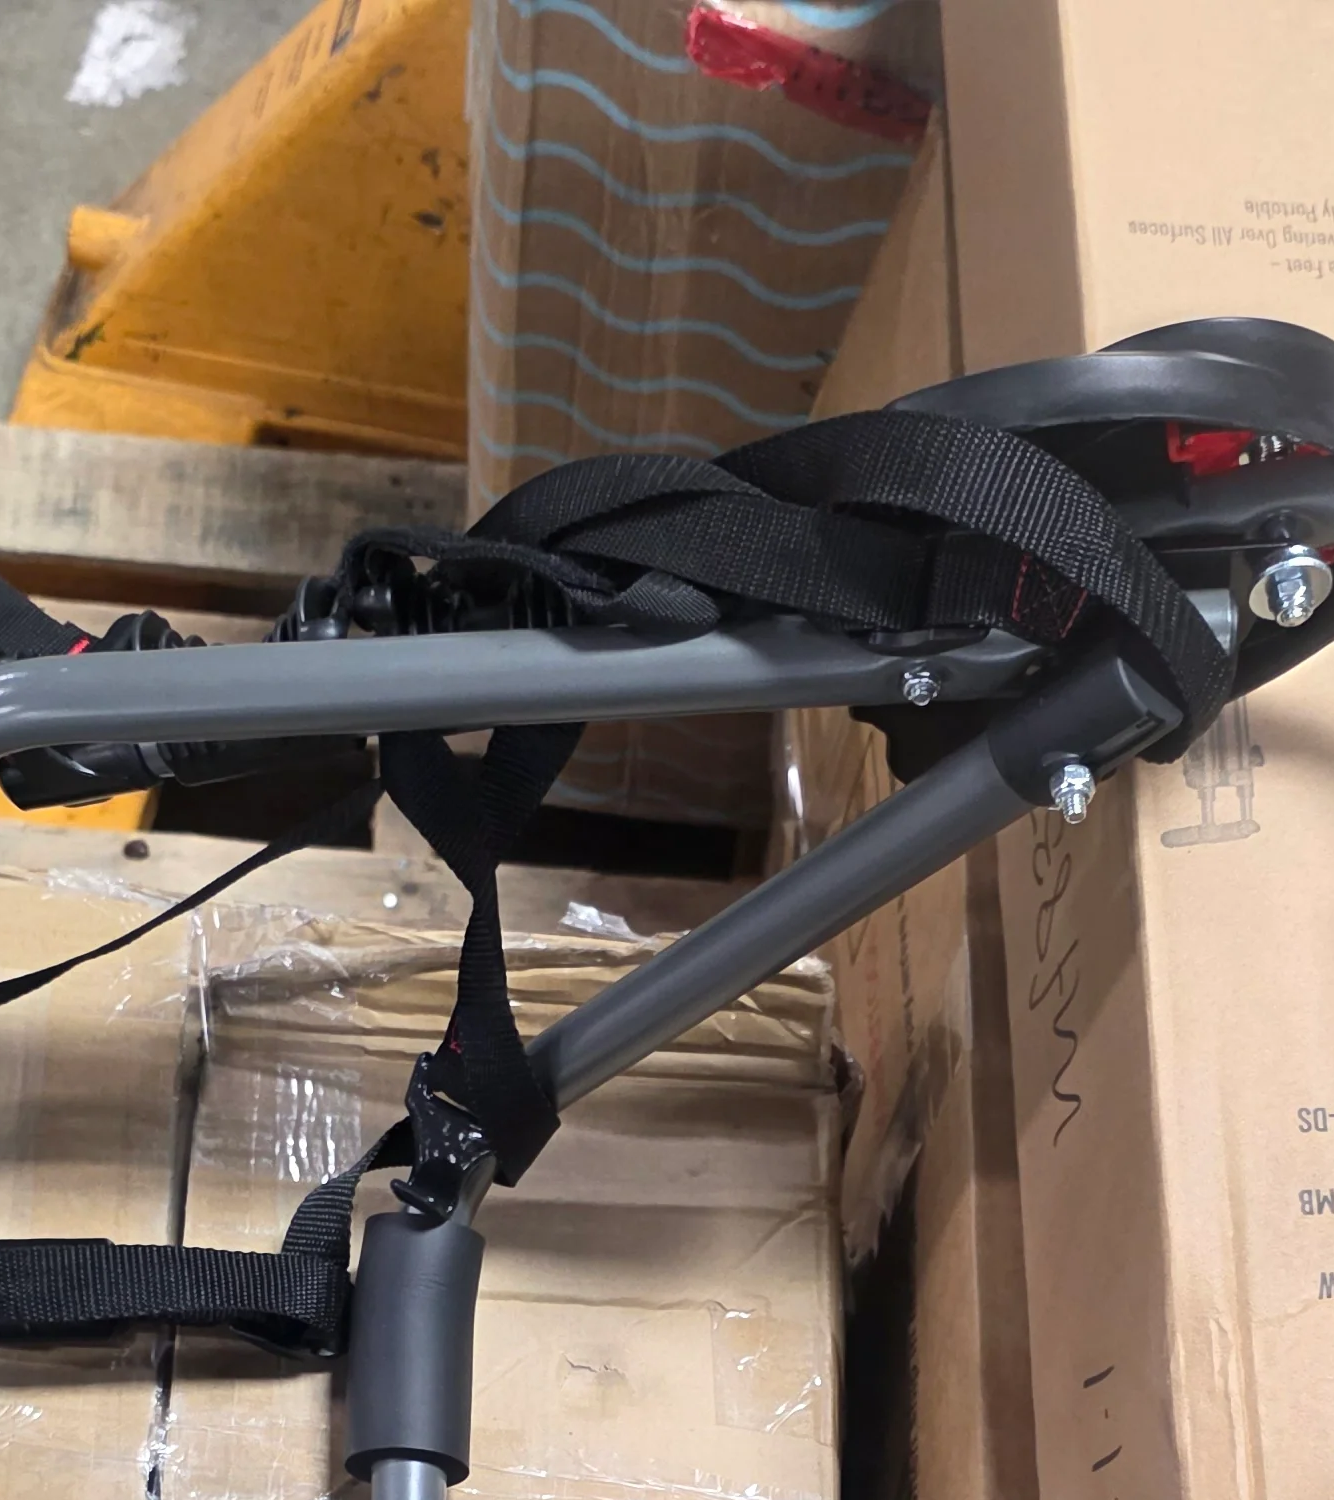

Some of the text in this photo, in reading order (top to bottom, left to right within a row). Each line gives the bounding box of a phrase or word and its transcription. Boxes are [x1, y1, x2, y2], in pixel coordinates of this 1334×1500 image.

[1243, 199, 1316, 223] Portable
[1126, 220, 1205, 245] Surfaces
[1211, 225, 1232, 245] All
[1238, 226, 1276, 249] Over
[1284, 257, 1322, 278] Feet
